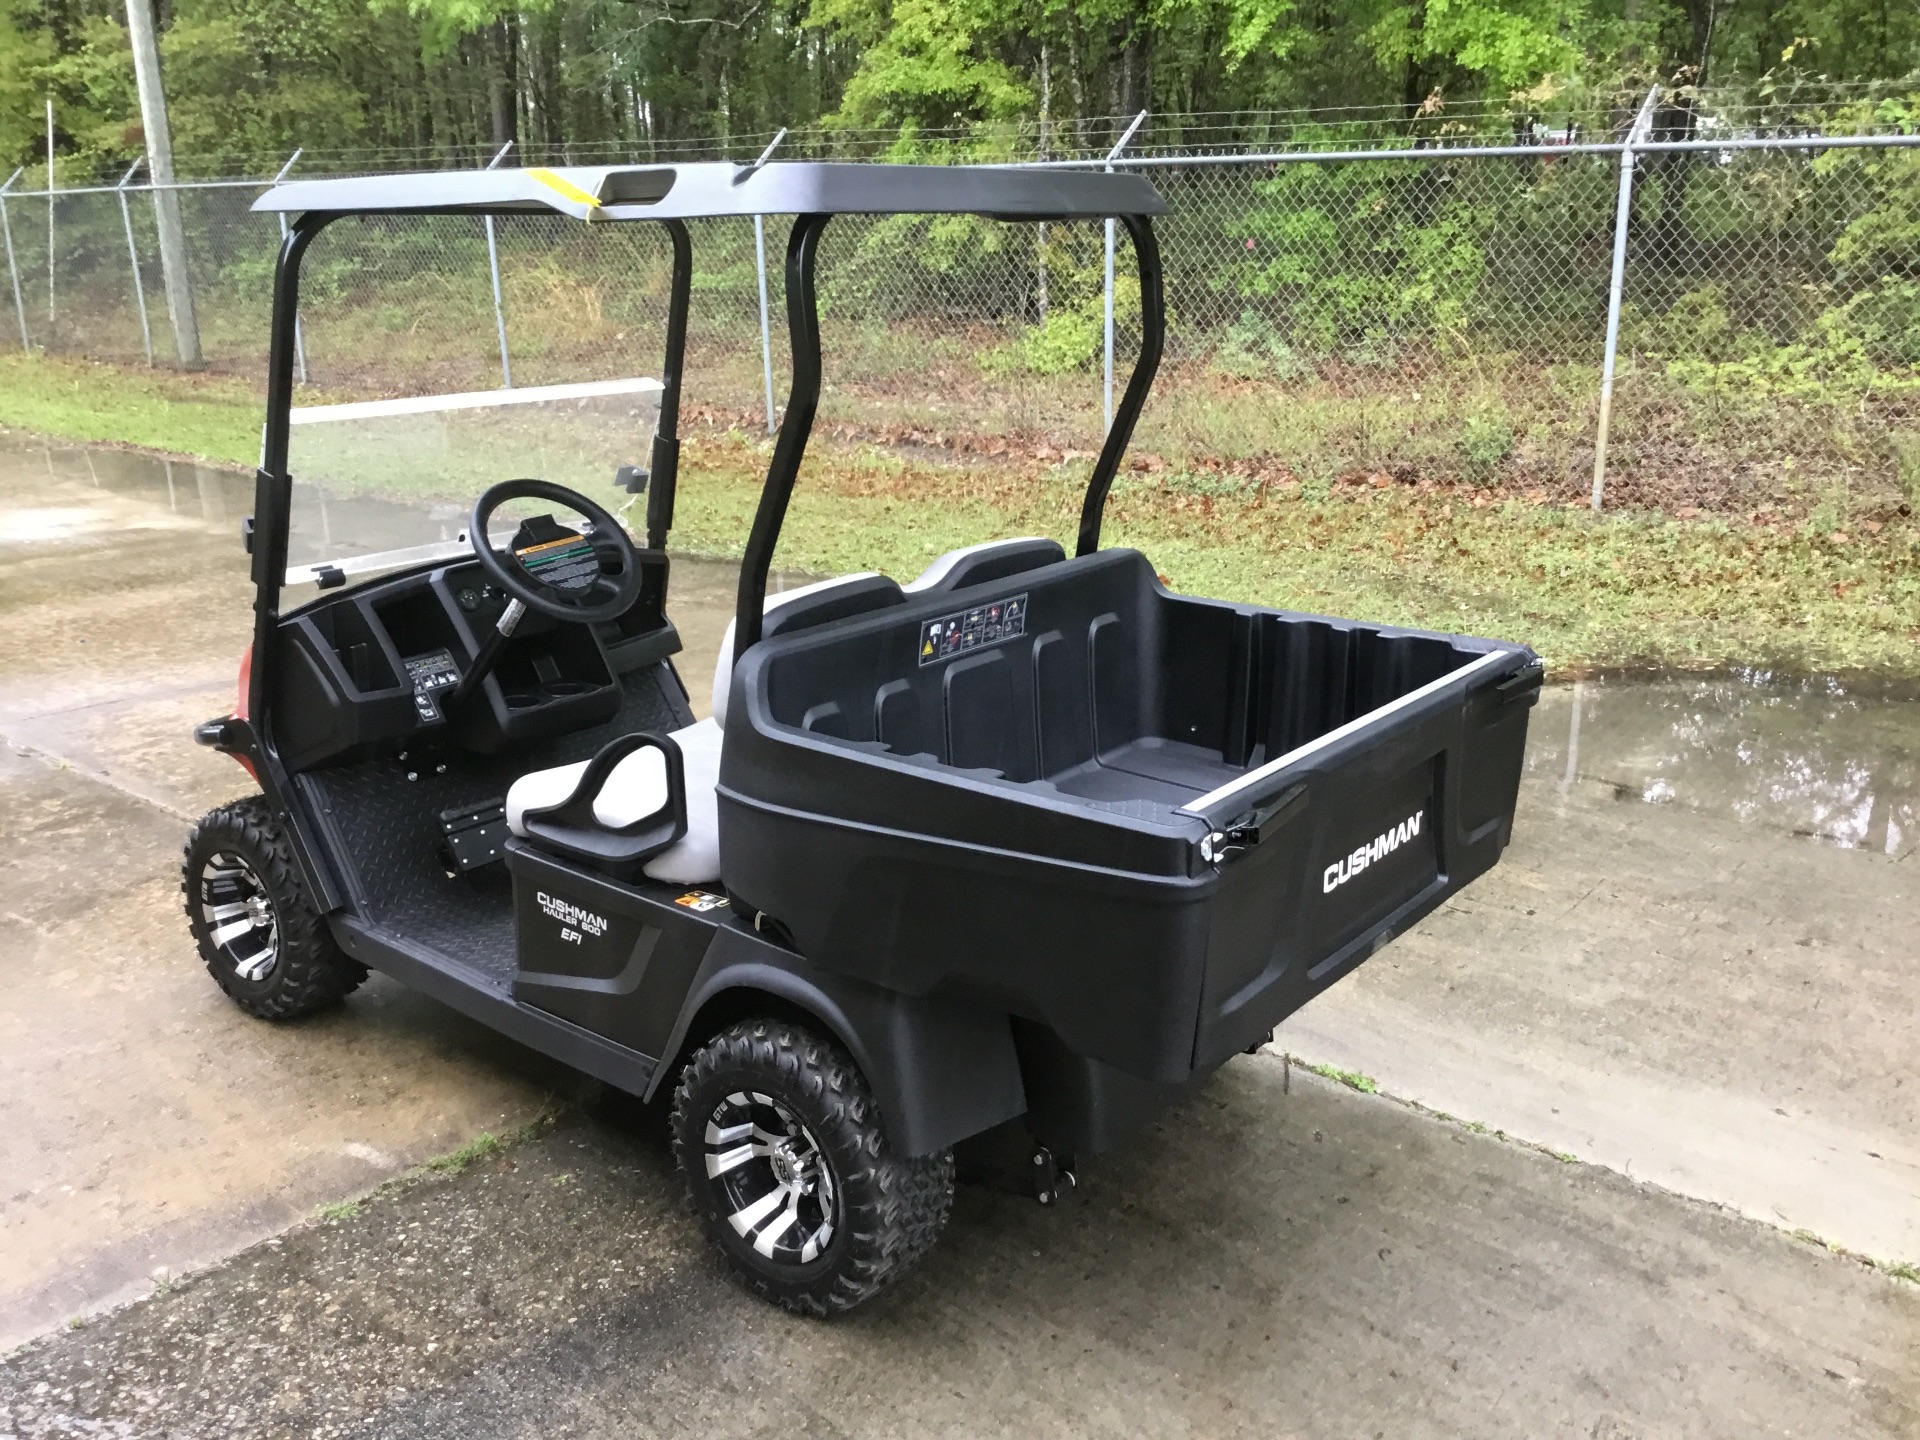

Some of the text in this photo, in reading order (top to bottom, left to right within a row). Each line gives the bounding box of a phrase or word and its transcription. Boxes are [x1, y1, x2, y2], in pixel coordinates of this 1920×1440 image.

[1323, 811, 1421, 893] CUSHMAN
[537, 892, 607, 930] CUSHMAN
[543, 905, 577, 926] HAULER
[561, 927, 582, 945] EFI
